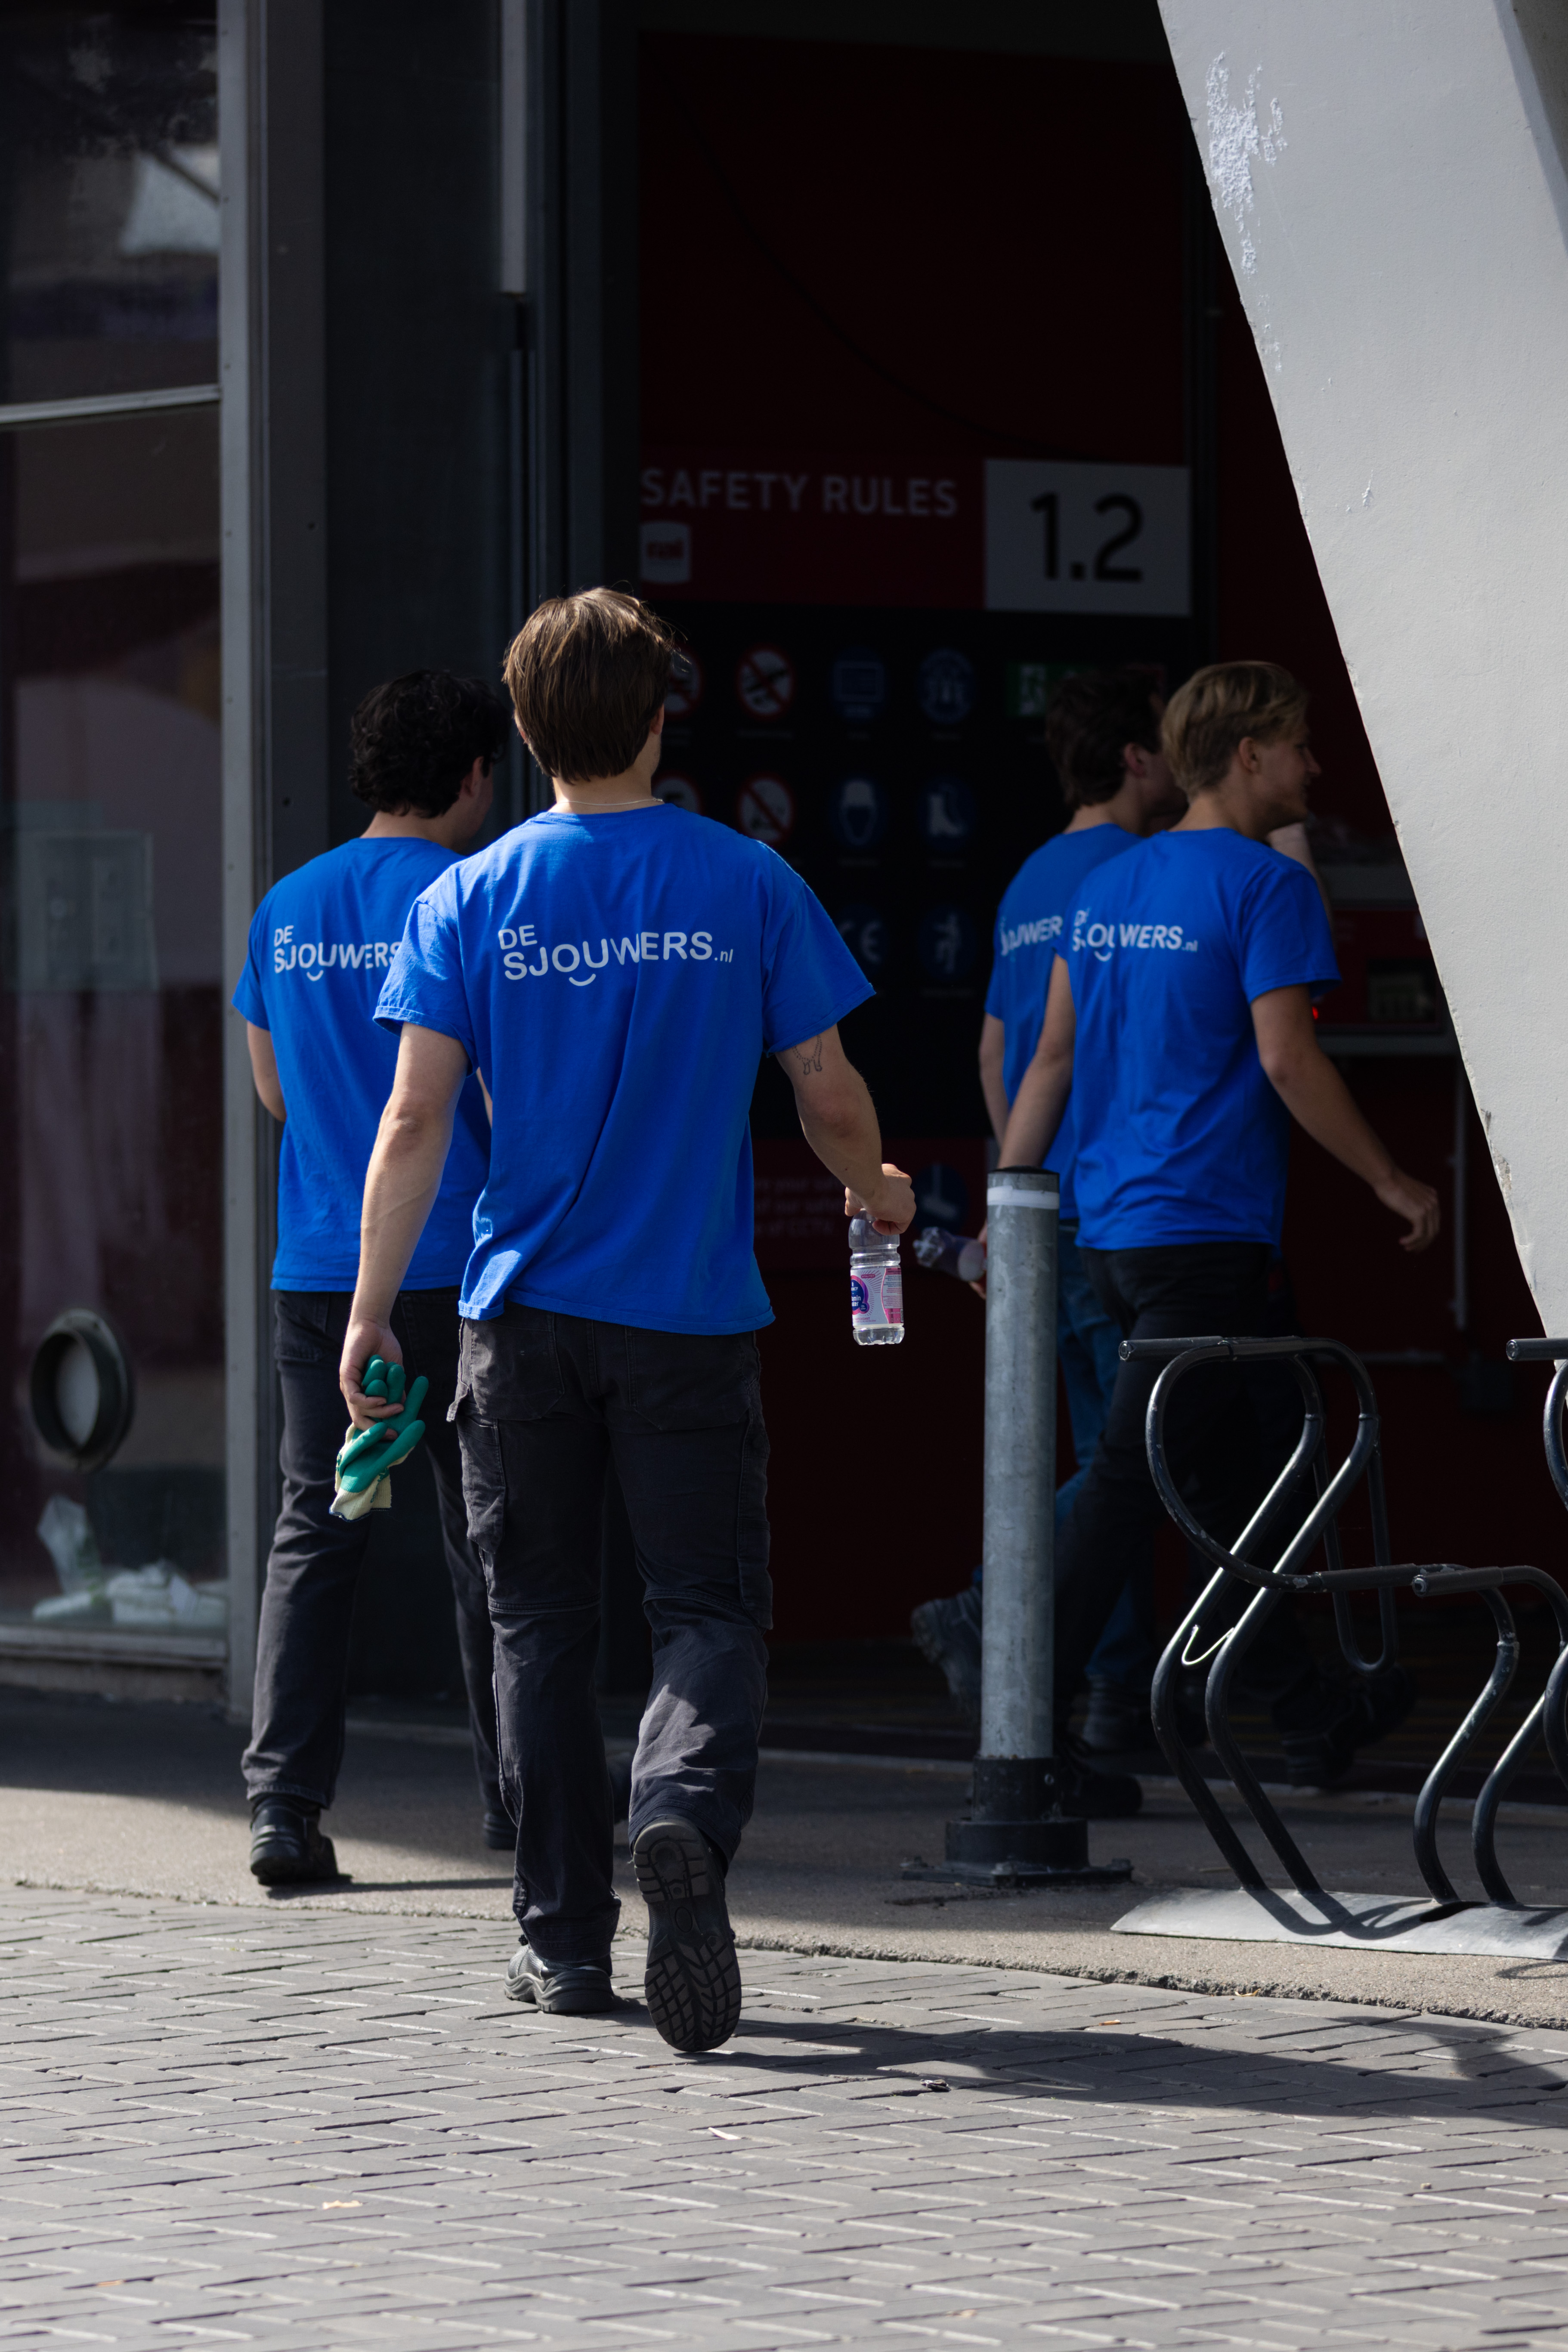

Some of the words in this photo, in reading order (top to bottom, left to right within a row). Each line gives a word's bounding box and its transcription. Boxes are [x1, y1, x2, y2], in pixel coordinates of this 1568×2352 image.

[641, 467, 810, 513] SAFETY
[821, 474, 959, 517] RULES
[1031, 492, 1143, 582] 1.2
[274, 925, 294, 947] DE
[498, 925, 537, 950] DE
[503, 931, 733, 980] SJOUWERS.nl
